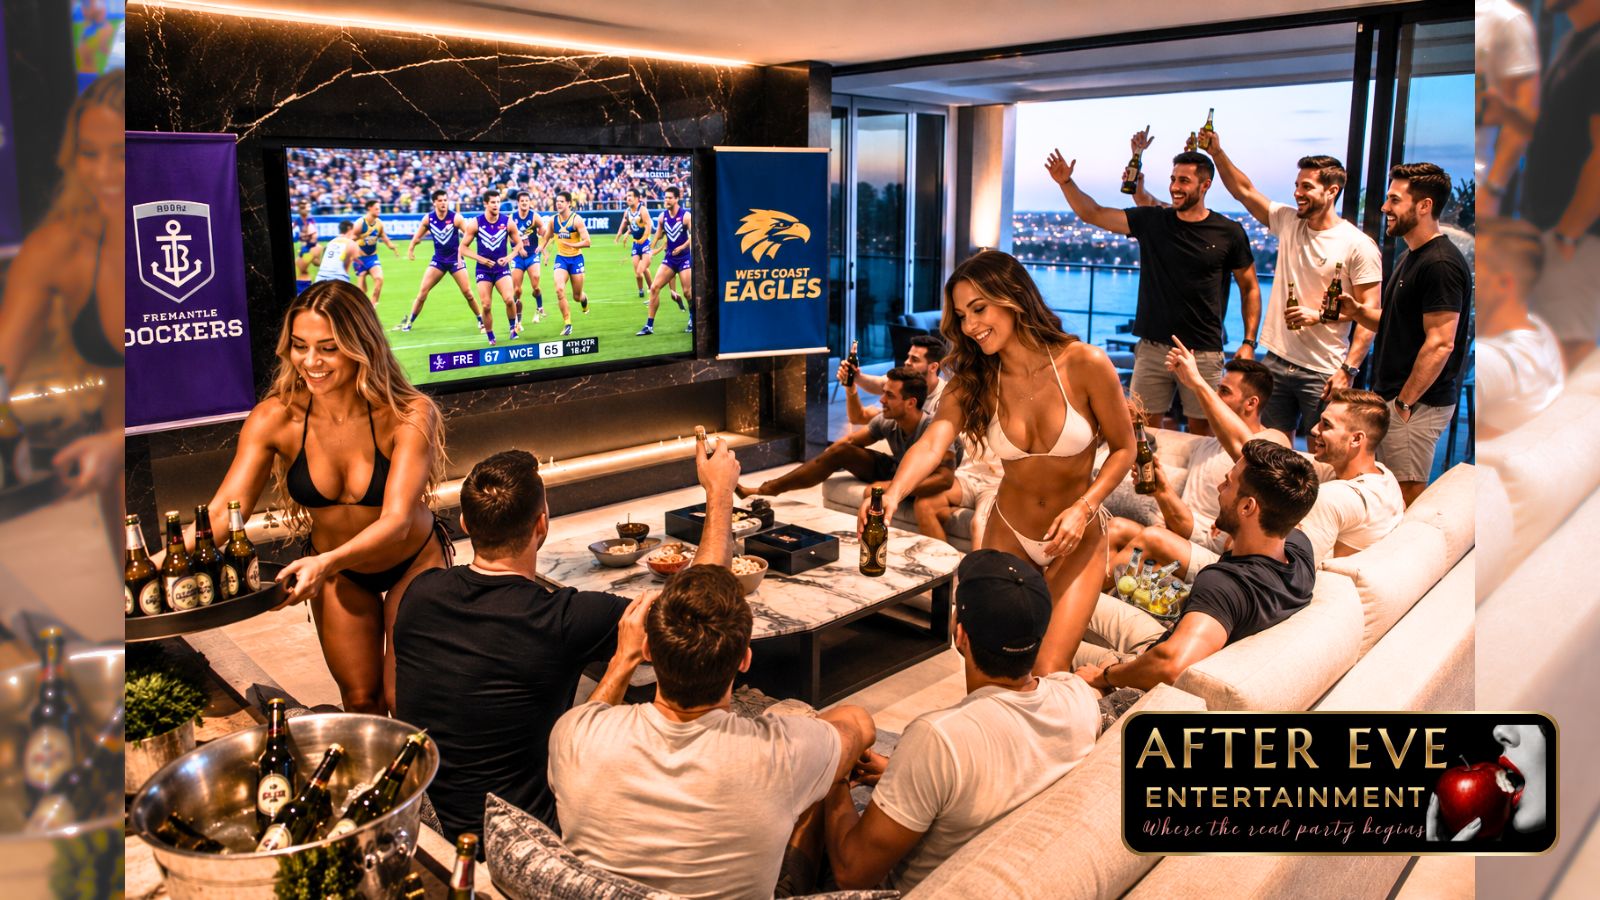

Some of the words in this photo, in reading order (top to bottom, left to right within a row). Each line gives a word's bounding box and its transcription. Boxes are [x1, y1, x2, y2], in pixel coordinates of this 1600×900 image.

[735, 269, 769, 280] WEST
[771, 267, 810, 279] COAST
[724, 277, 822, 302] EAGLES
[142, 308, 218, 323] FREMANTLE
[453, 354, 474, 366] FRE
[484, 350, 500, 363] 67
[509, 347, 534, 359] WCE
[544, 344, 559, 356] 65
